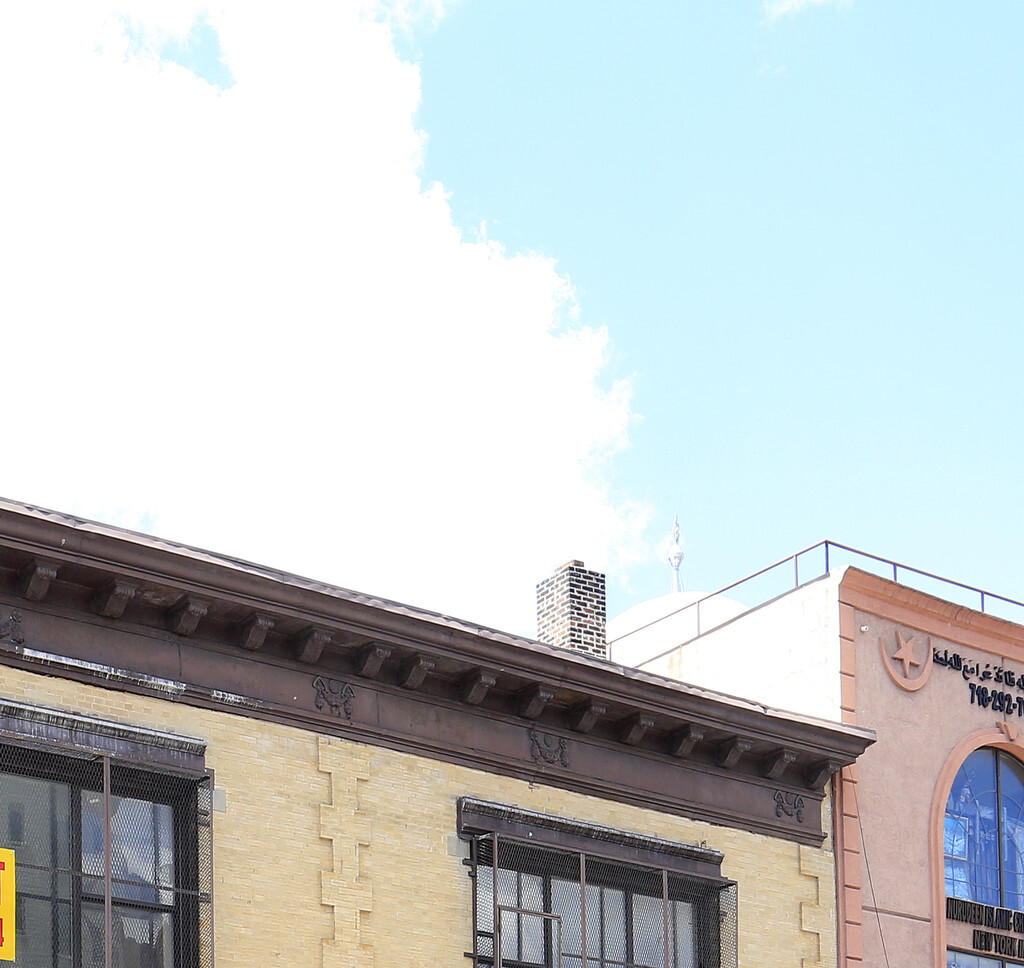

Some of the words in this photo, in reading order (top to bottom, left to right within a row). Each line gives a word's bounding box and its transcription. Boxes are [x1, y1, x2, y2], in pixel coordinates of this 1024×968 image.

[969, 683, 1024, 717] 718-292-7
[972, 929, 994, 952] NEW
[993, 934, 1018, 957] YORK
